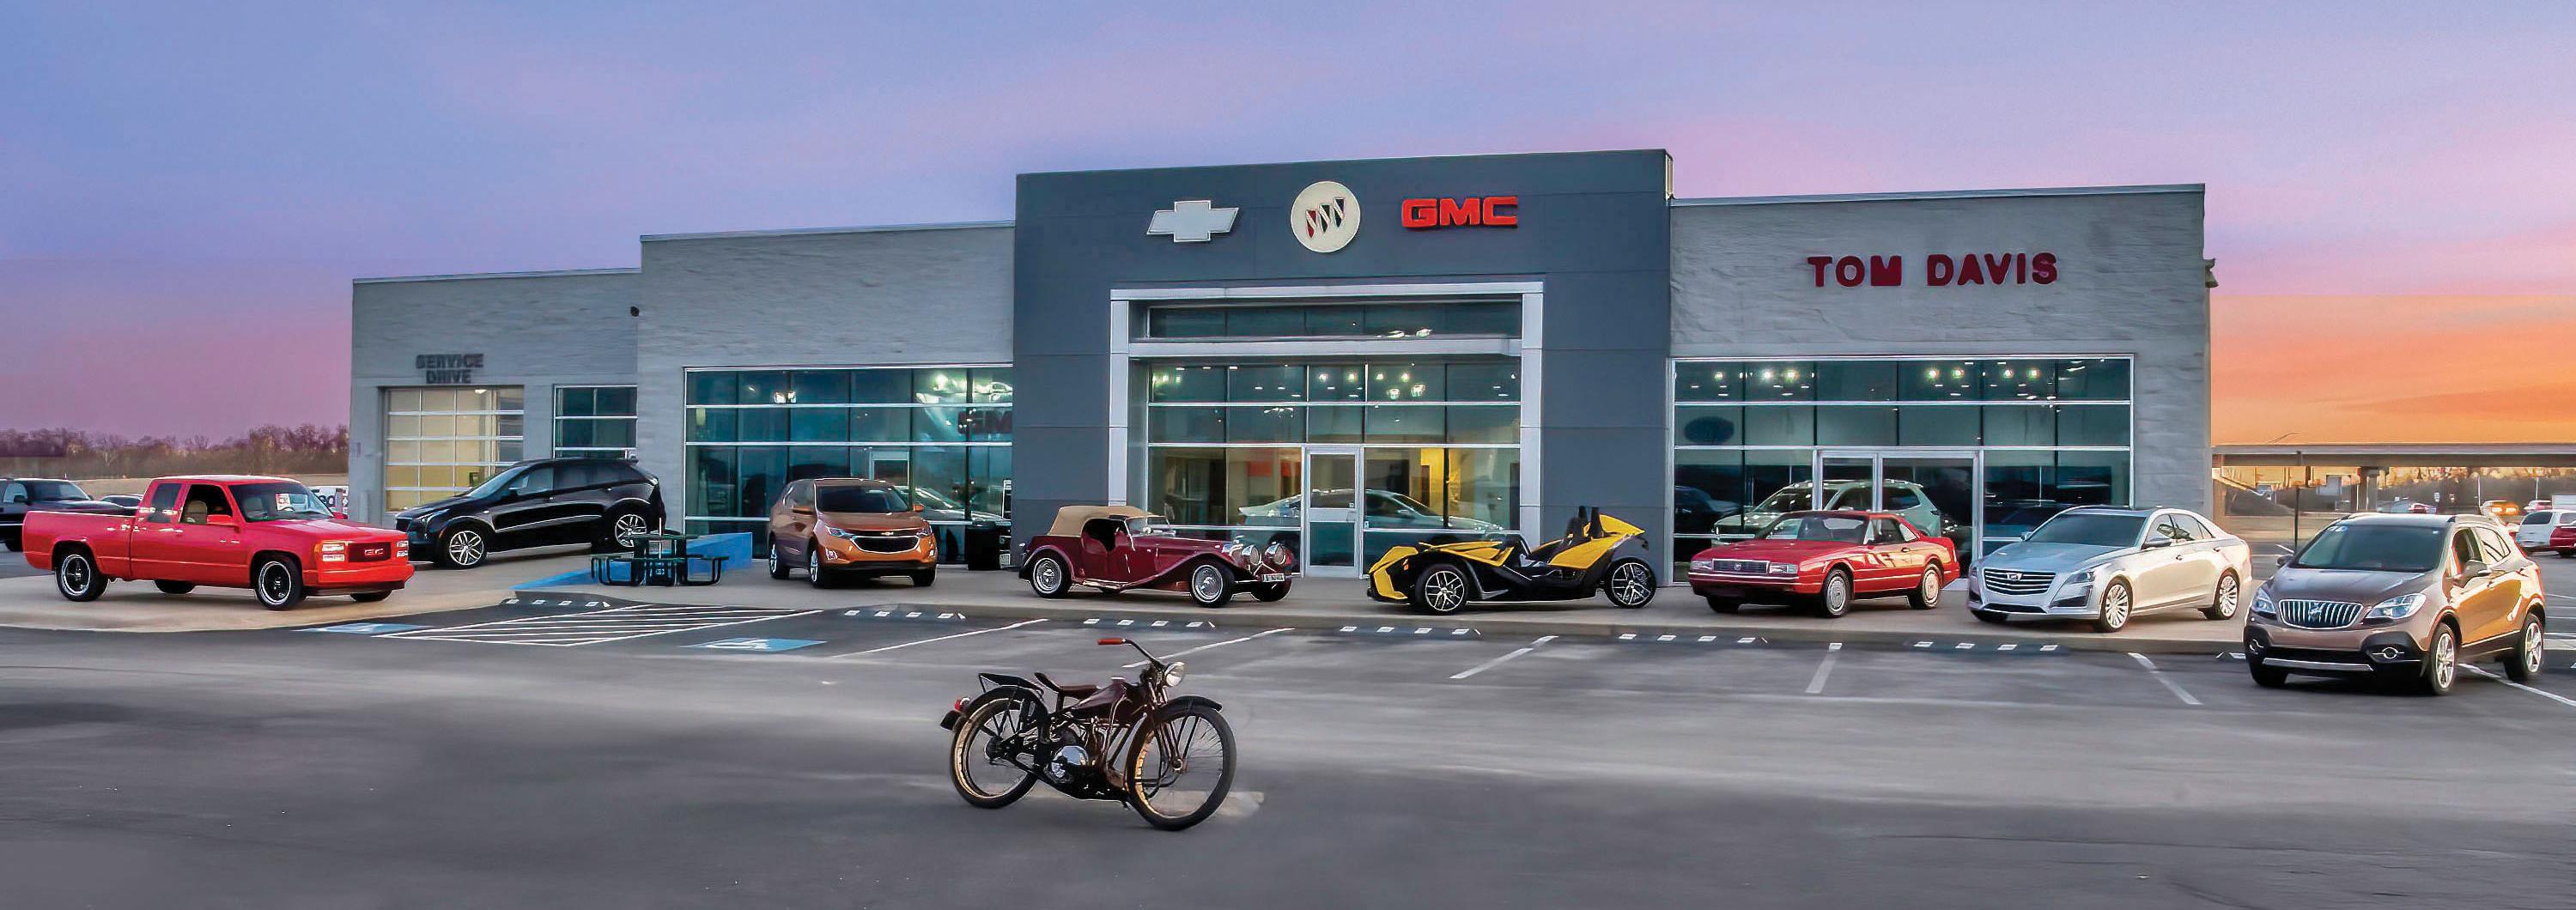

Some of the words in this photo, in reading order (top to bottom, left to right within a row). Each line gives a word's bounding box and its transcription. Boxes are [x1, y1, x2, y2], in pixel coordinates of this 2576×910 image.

[1402, 196, 1517, 228] GMC
[1807, 255, 1902, 287] TOM
[1927, 252, 2057, 286] DAVIS
[416, 354, 483, 369] SERVICE
[426, 369, 471, 384] DRIVE
